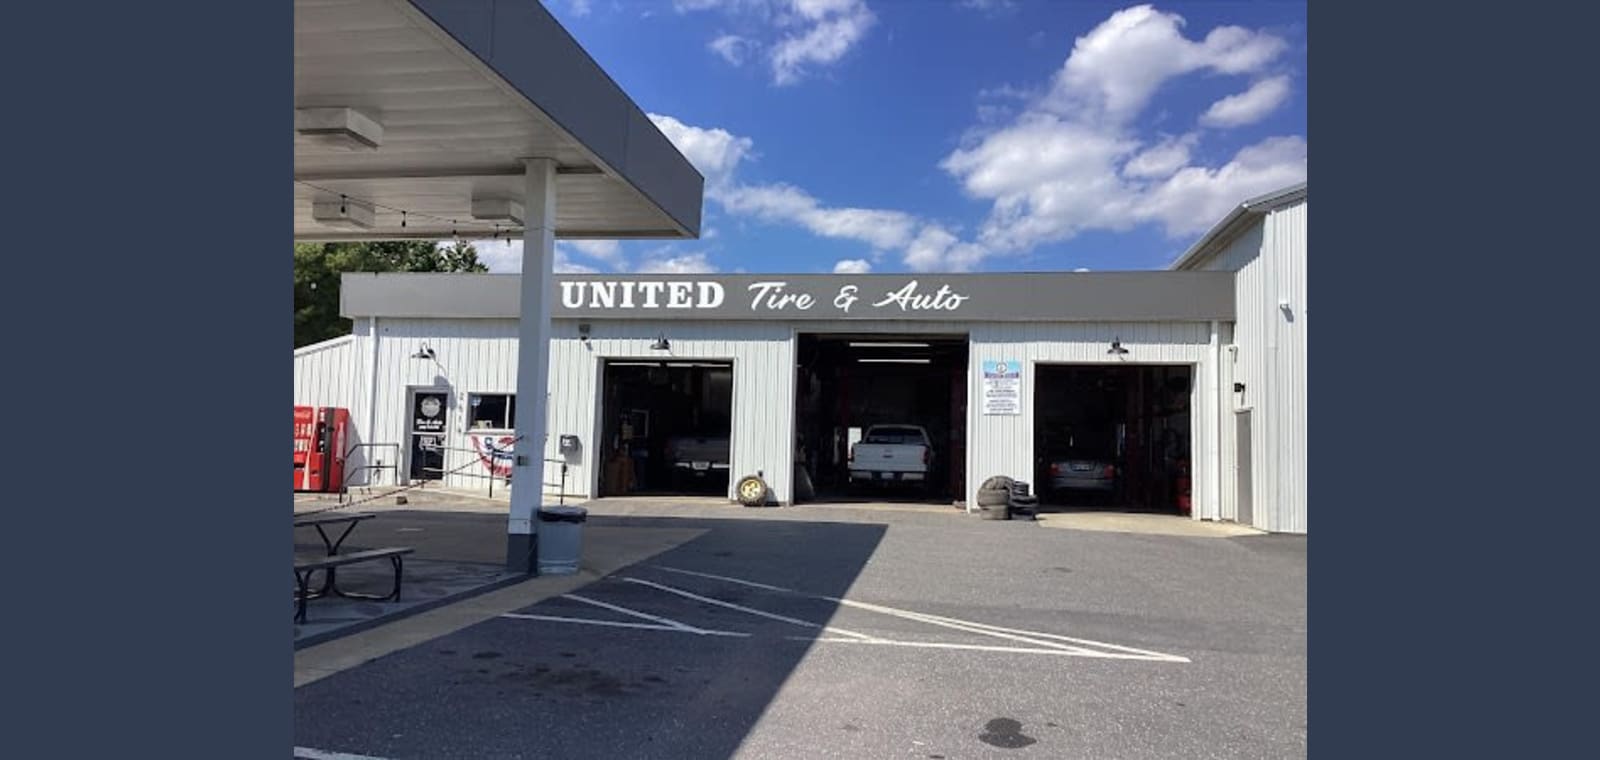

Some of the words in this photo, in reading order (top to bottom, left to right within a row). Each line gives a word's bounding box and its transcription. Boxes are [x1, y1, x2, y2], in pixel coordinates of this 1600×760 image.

[560, 281, 725, 309] UNITED
[748, 281, 816, 311] Tire
[834, 285, 859, 312] &
[872, 279, 969, 311] Auto
